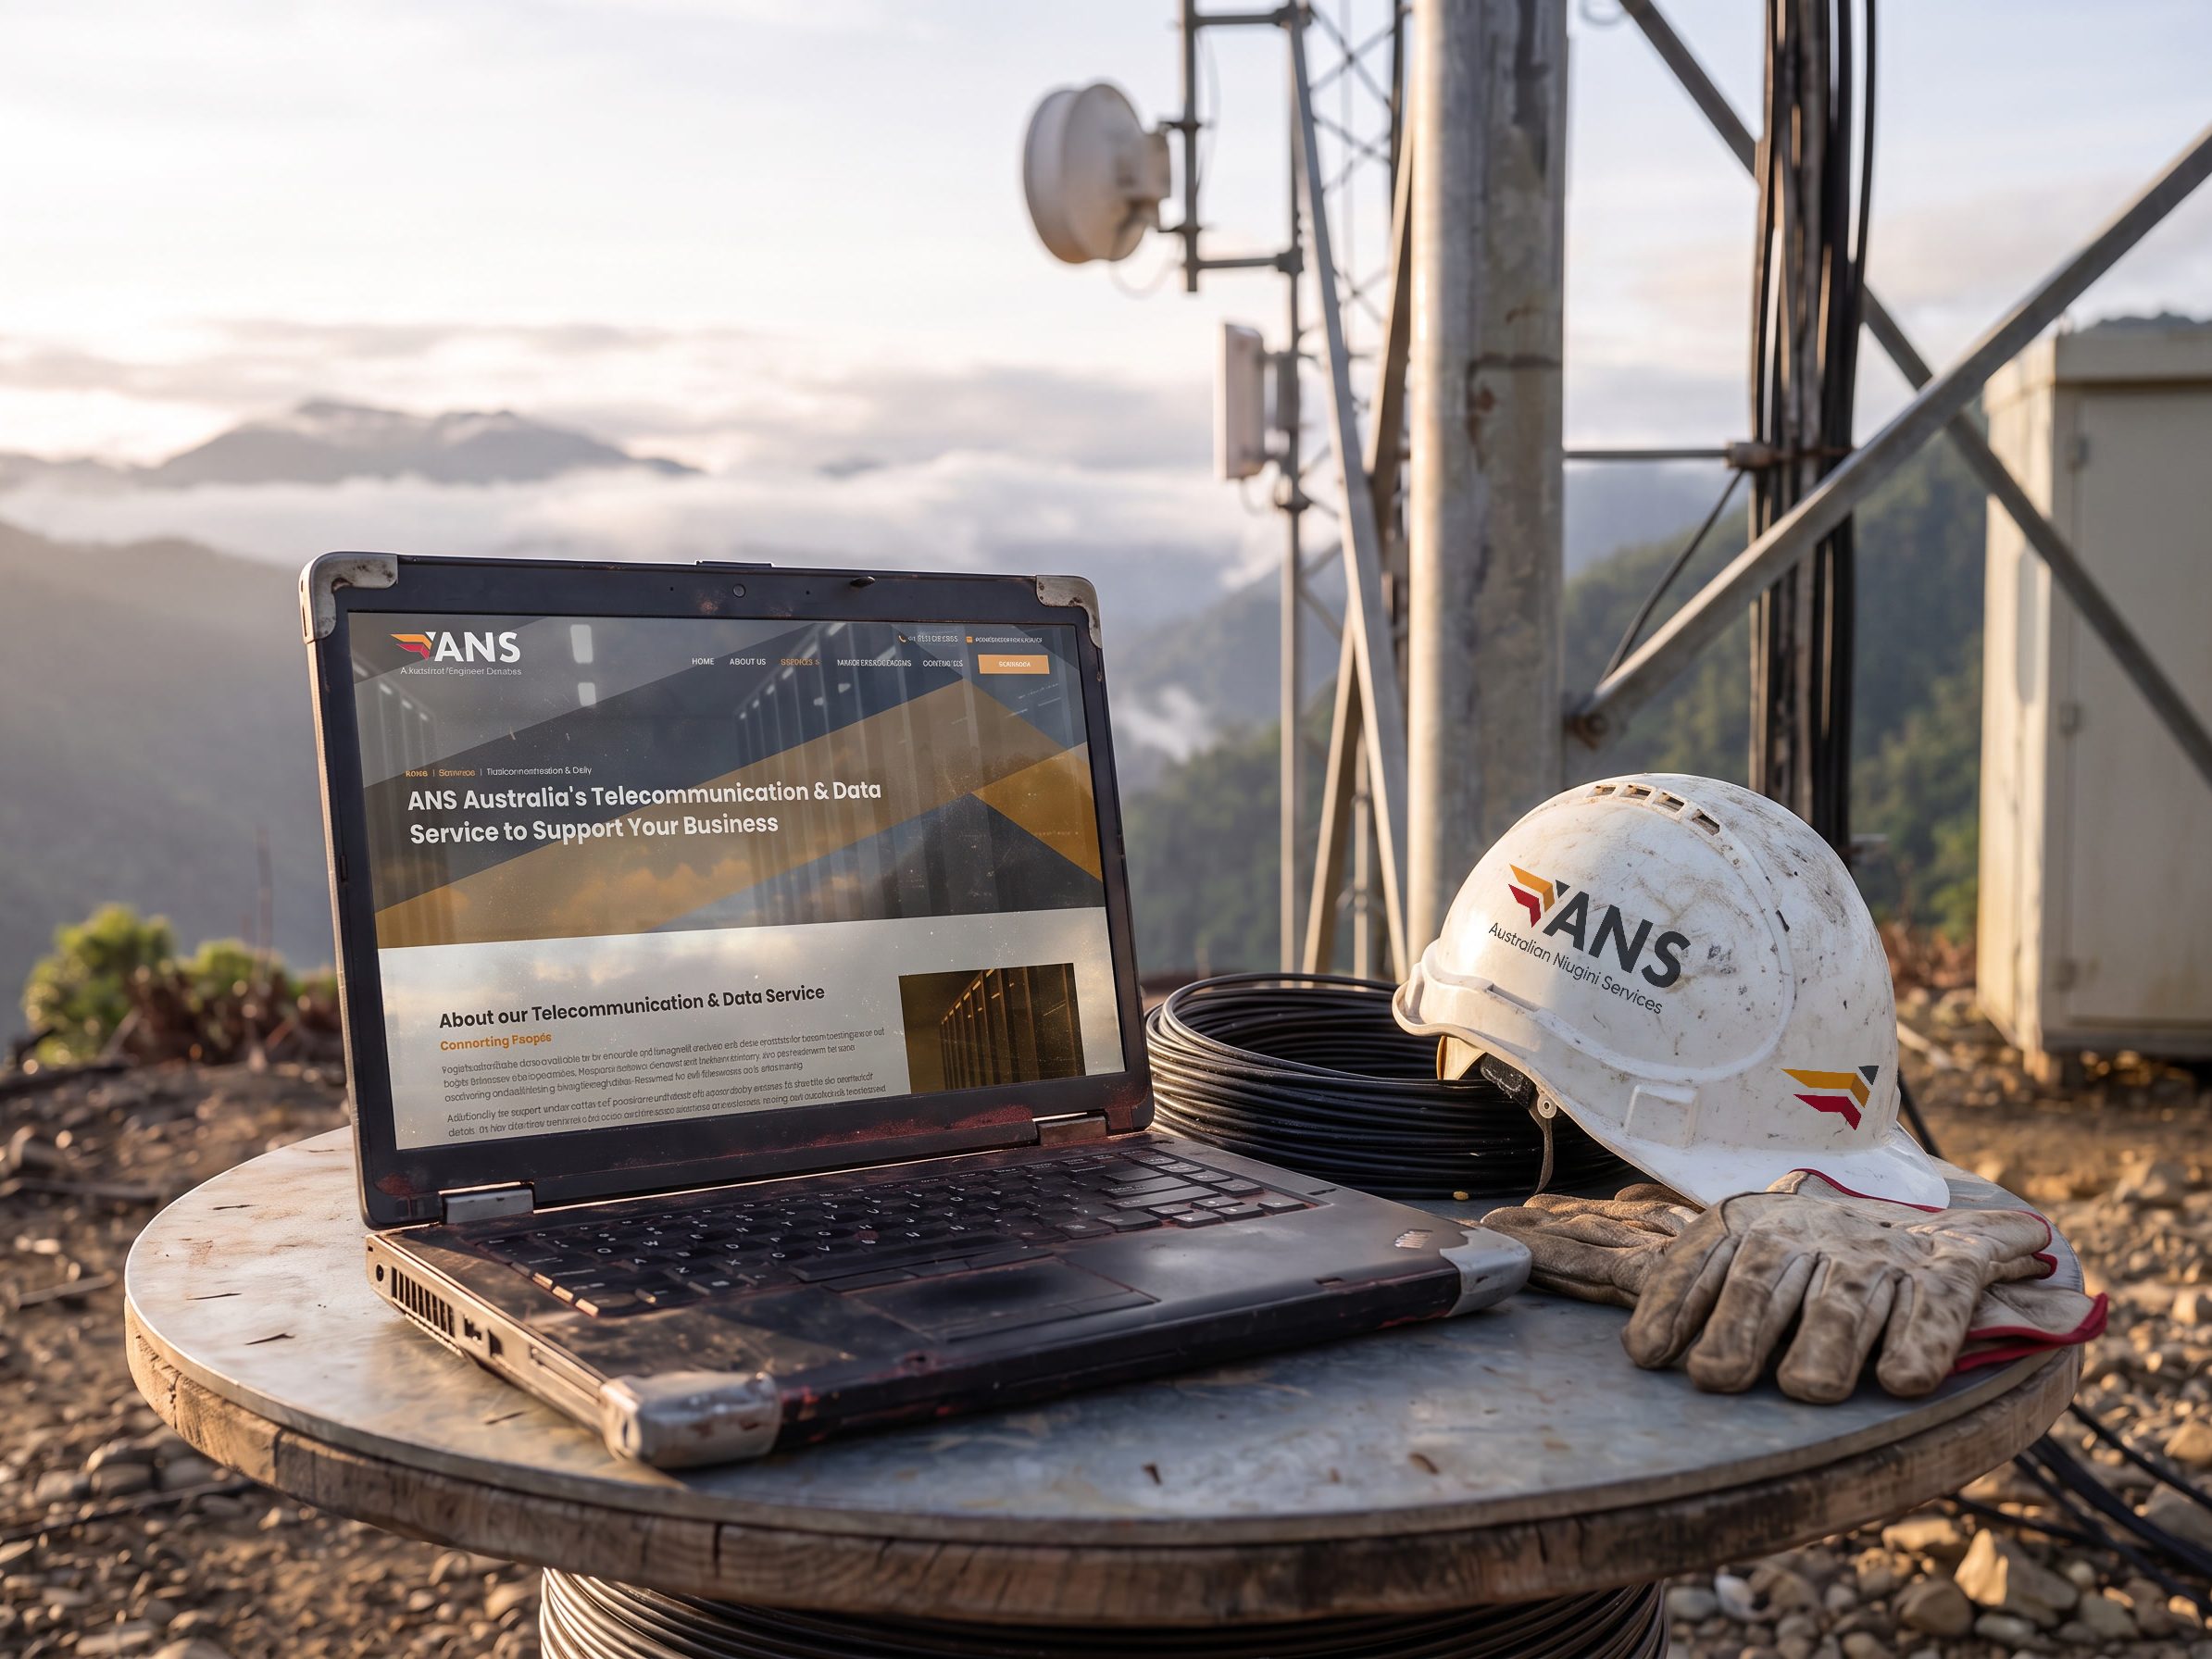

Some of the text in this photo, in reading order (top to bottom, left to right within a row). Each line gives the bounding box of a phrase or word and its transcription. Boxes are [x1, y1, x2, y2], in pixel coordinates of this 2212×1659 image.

[434, 631, 520, 663] ANS
[407, 781, 881, 811] ANS Australia's Telecommunication & Data
[410, 812, 779, 845] Service to Support Your Business
[1543, 891, 1692, 989] ANS
[1488, 922, 1663, 1015] Australian Niugini Services
[439, 984, 825, 1029] About our Telecommunication & Data Service
